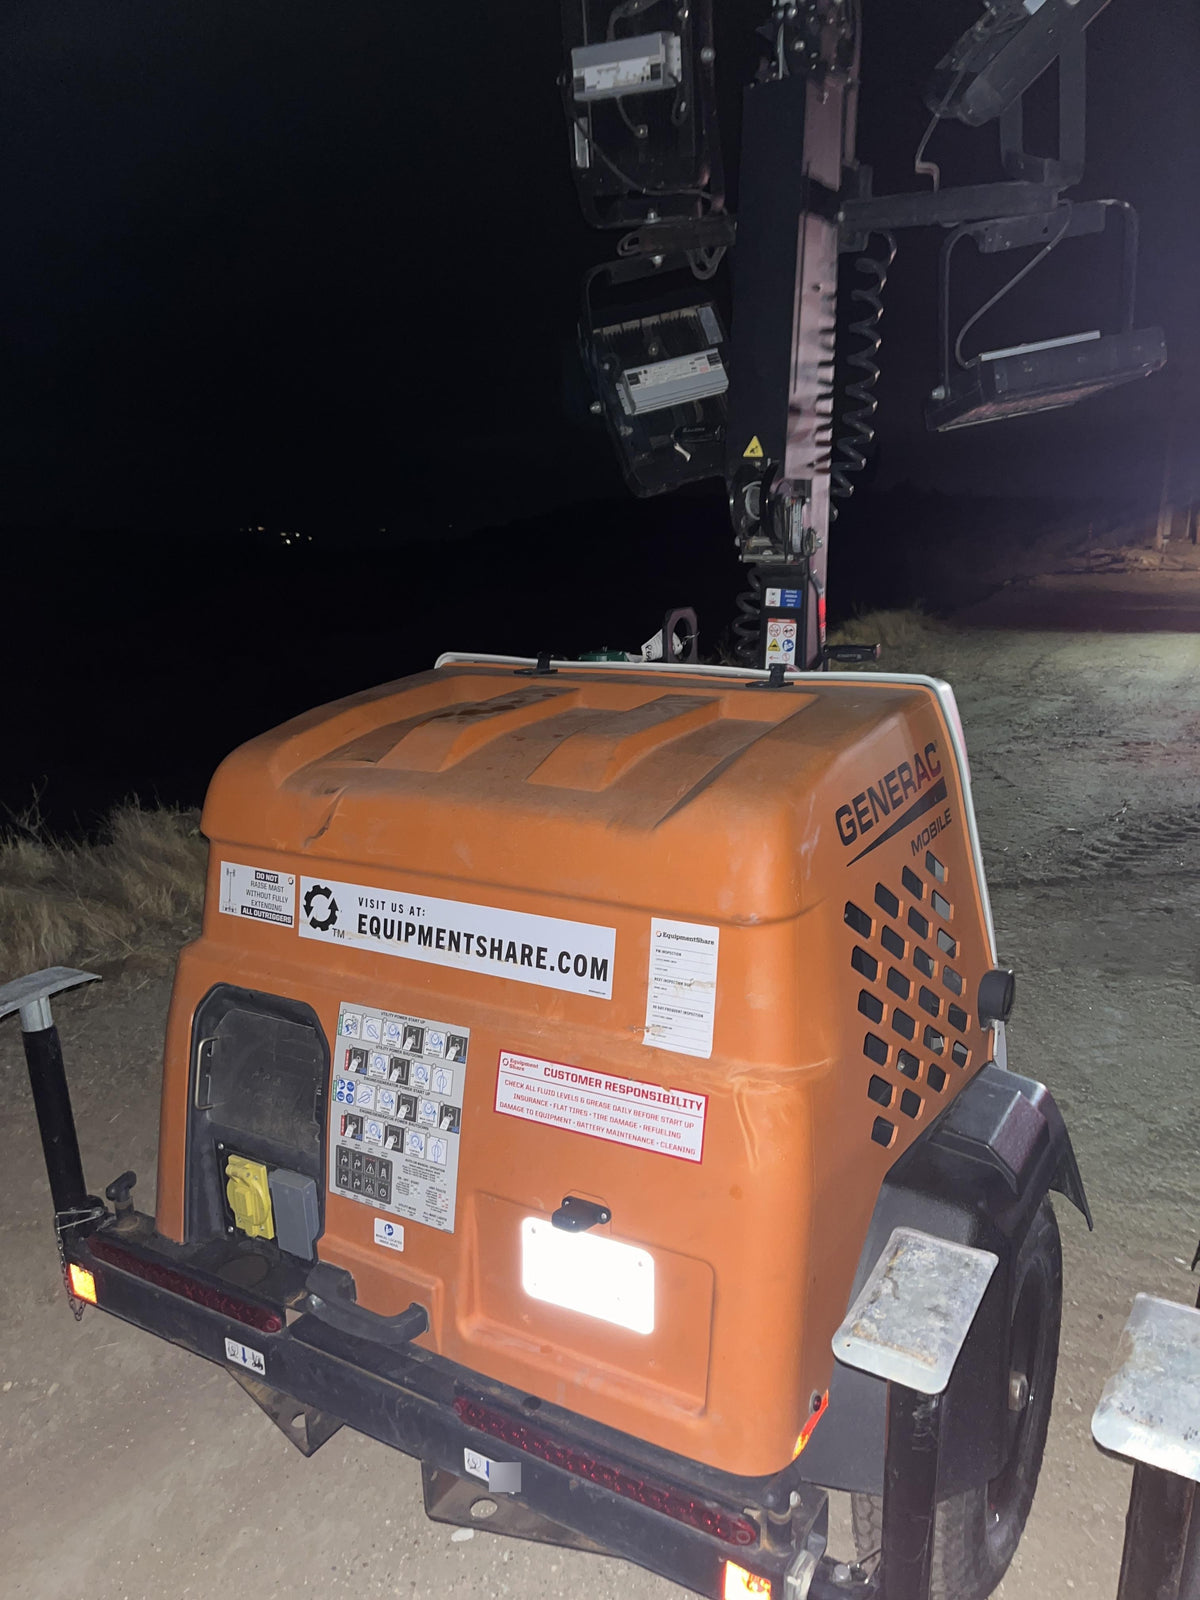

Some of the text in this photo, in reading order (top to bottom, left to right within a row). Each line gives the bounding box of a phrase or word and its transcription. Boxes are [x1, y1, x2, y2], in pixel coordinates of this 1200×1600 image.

[835, 742, 941, 846] GENERAC
[911, 808, 952, 856] MOBILE
[266, 873, 278, 882] NOT
[251, 880, 284, 892] RAISE MAST
[246, 889, 288, 903] WITHOUT FULLY
[251, 900, 282, 911] EXTENDING
[358, 897, 425, 916] VISIT US AT:
[254, 910, 291, 923] OUTRIGGERS
[332, 928, 345, 939] TM
[662, 932, 714, 945] EquipmentShare
[358, 914, 608, 982] EQUIPMENTSHARE.COM
[510, 1058, 538, 1069] Equipment
[544, 1067, 702, 1111] CUSTOMER RESPONSIBILITY
[505, 1080, 524, 1088] CHECK
[525, 1084, 536, 1092] ALL
[537, 1087, 555, 1097] FLUID
[556, 1092, 579, 1102] LEVELS
[586, 1099, 611, 1110] GREASE
[613, 1105, 632, 1114] DAILY
[633, 1110, 659, 1122] BEFORE
[661, 1116, 682, 1126] START
[514, 1093, 681, 1139] INSURANCE FLAT TIRES TIRE DAMAGE REFUELING
[500, 1102, 524, 1113] DAMAGE
[535, 1110, 572, 1124] EQUIPMENT
[576, 1121, 604, 1134] BATTERY
[606, 1128, 654, 1145] MAINTENANCE
[660, 1142, 696, 1155] CLEANING
